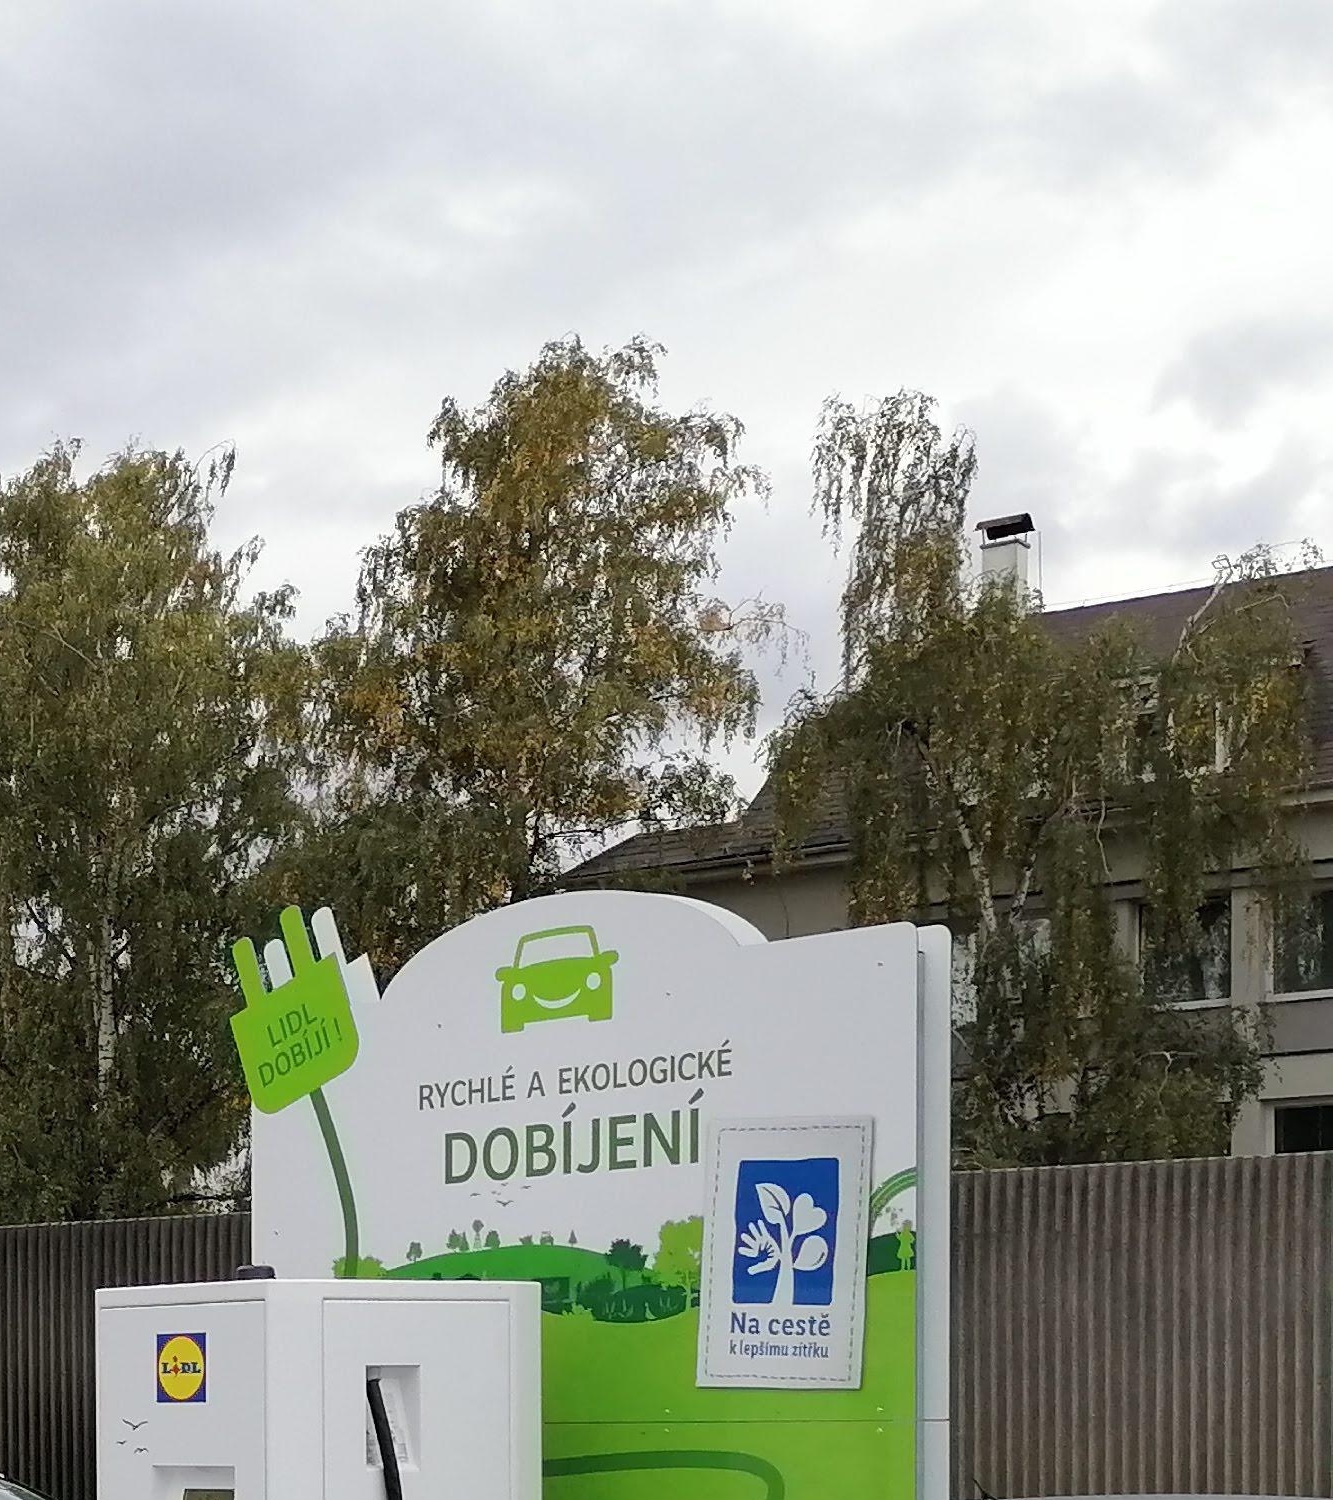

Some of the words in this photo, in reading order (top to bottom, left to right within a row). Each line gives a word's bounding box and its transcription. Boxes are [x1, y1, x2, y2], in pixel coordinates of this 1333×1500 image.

[266, 1003, 318, 1048] LIDL
[418, 1064, 517, 1111] RYCHLÉ
[526, 1070, 546, 1099] A
[557, 1039, 734, 1096] EKOLOGICKÉ
[444, 1087, 705, 1185] DOBÍJENÍ
[730, 1311, 761, 1335] Na
[767, 1312, 831, 1337] cestě
[729, 1339, 737, 1355] k
[739, 1339, 789, 1359] lepšímu
[792, 1341, 829, 1359] zítřku
